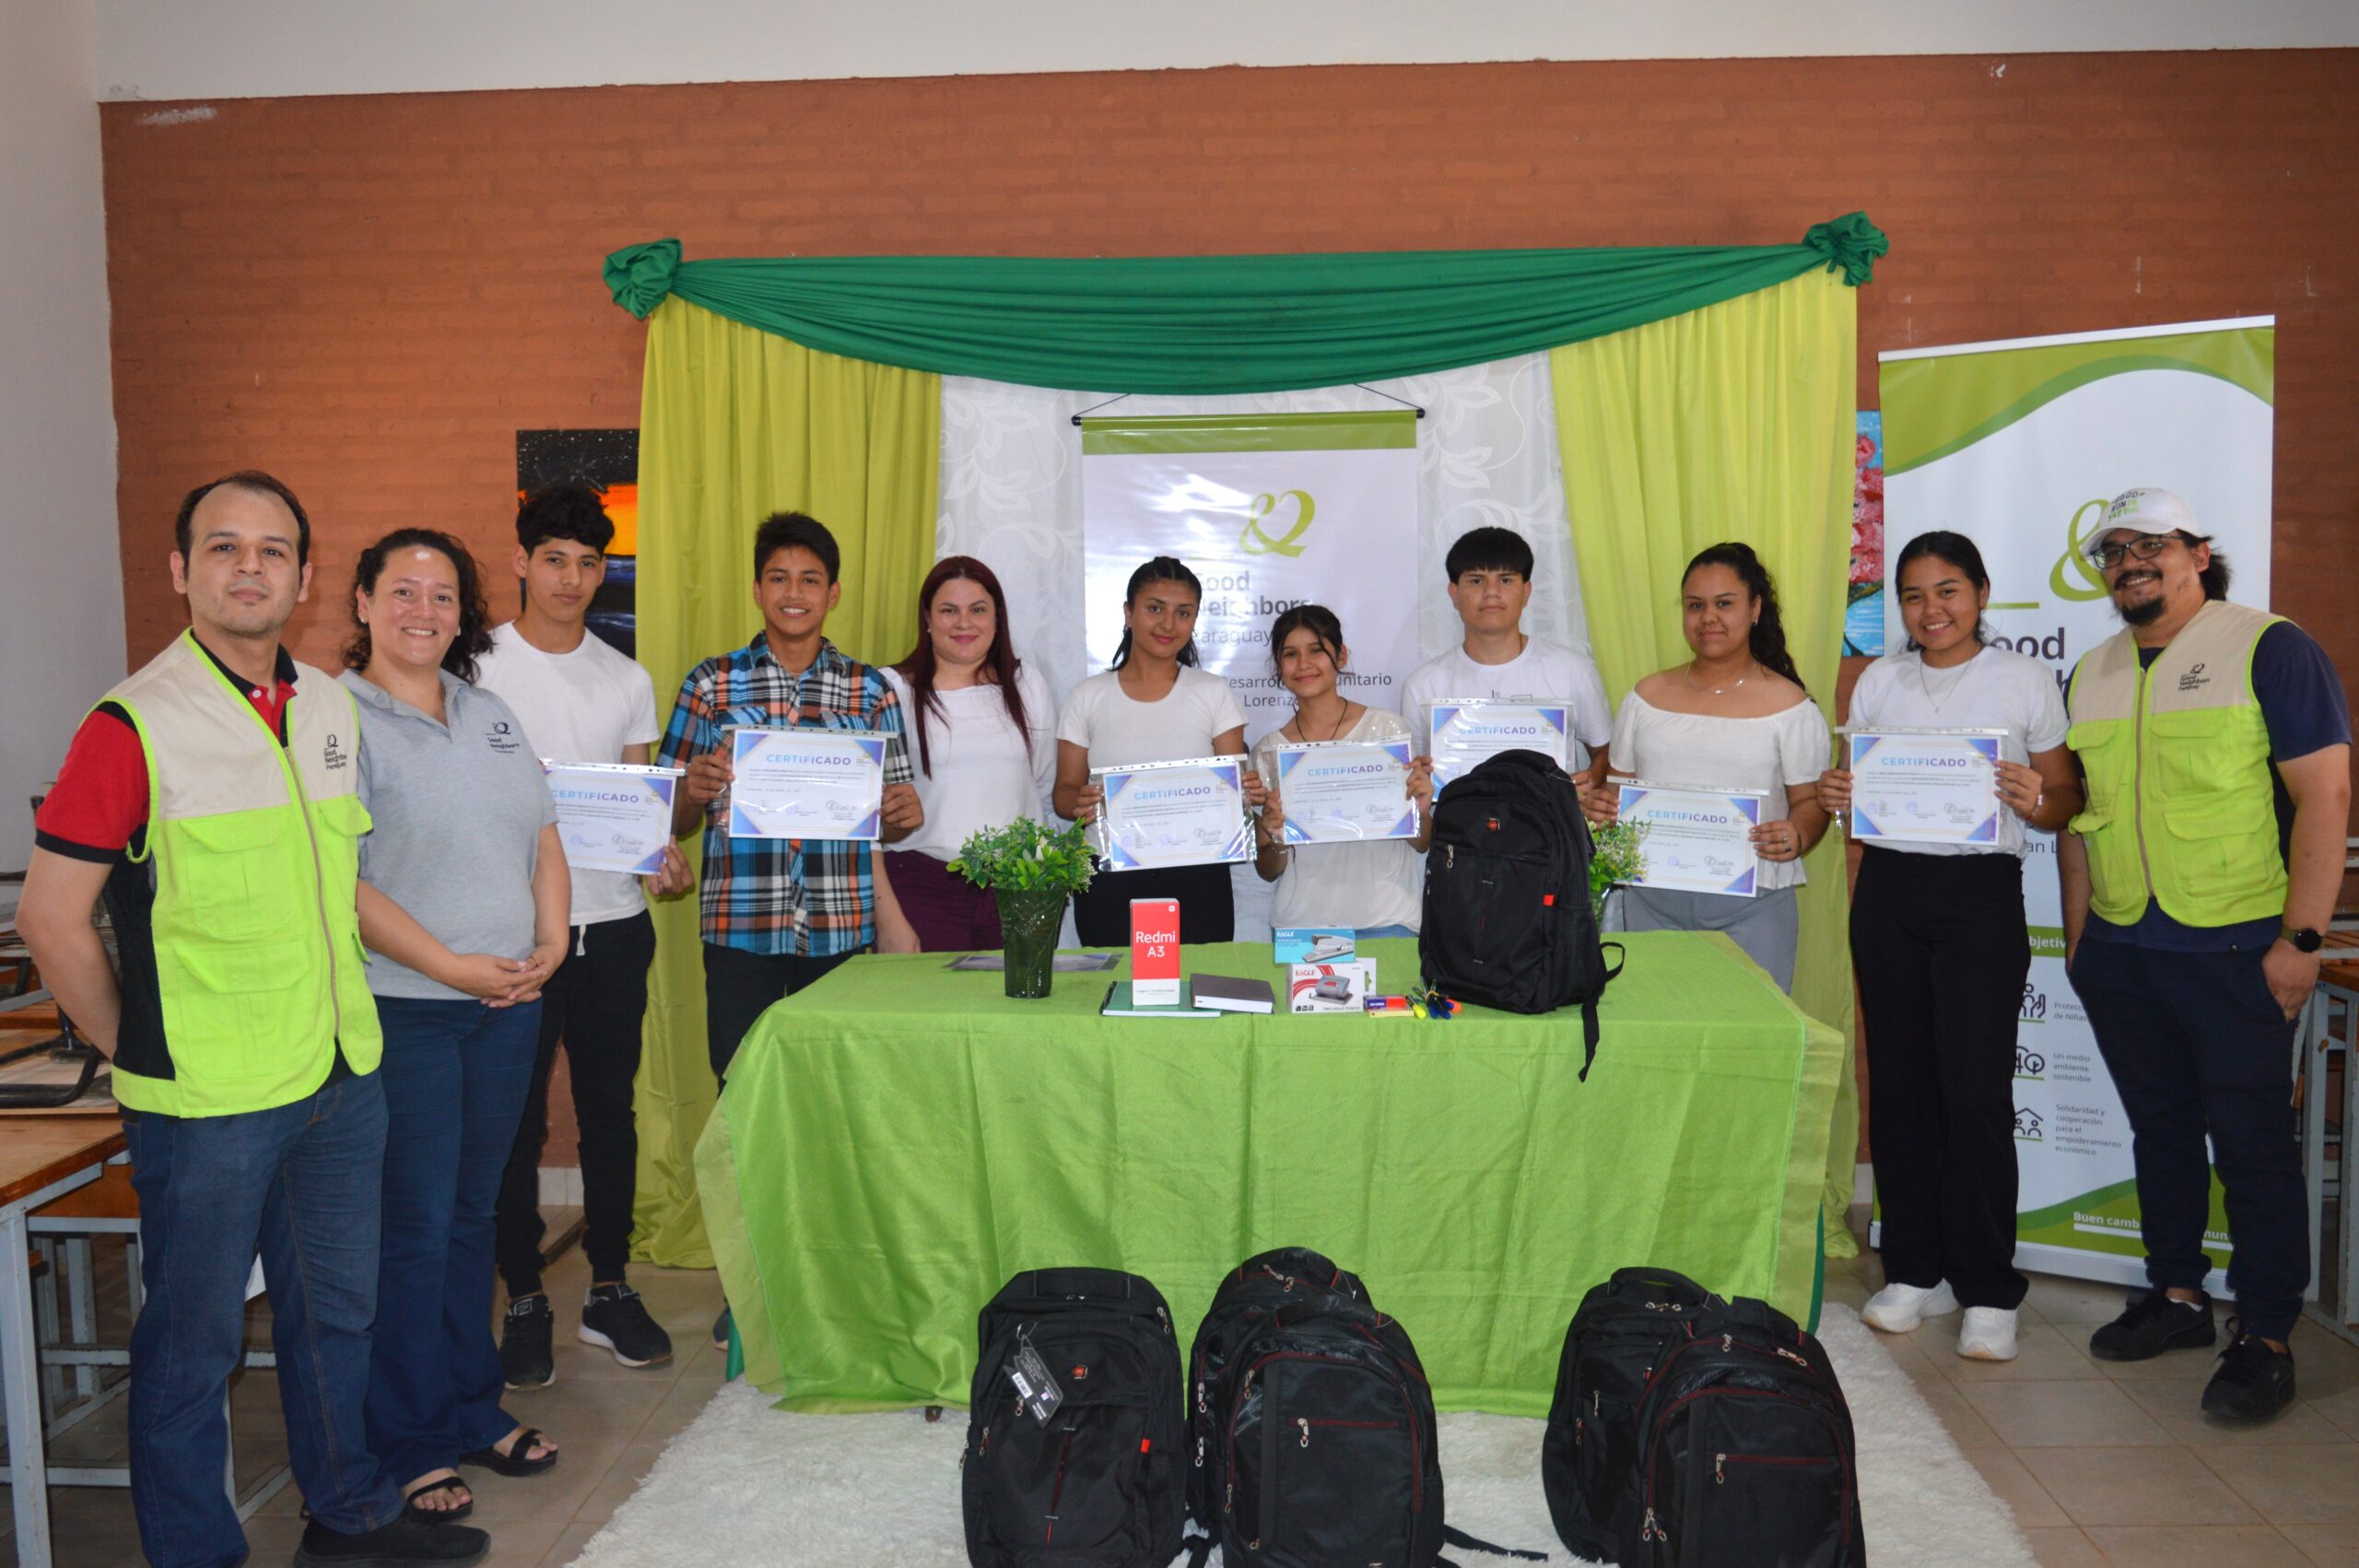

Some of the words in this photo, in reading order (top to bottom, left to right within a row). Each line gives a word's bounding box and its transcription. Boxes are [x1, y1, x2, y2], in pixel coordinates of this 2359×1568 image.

[766, 754, 851, 766] CERTIFICADO
[1881, 756, 1966, 767] CERTIFICADO
[1307, 764, 1383, 777] CERTIFICADO
[1134, 786, 1211, 801] CERTIFICADO
[1647, 810, 1728, 824] CERTIFICADO
[1135, 930, 1176, 943] Redmi
[1146, 945, 1165, 958] A3
[2066, 1053, 2090, 1062] medio
[2053, 1063, 2089, 1072] ambiente
[2053, 1073, 2092, 1082] sostenible
[2056, 1104, 2099, 1115] Solidaridad
[2056, 1115, 2103, 1126] cooperación
[2055, 1136, 2121, 1149] empoderamiento
[2055, 1145, 2097, 1156] económico
[2073, 1211, 2104, 1224] Buen
[2107, 1215, 2140, 1229] camb
